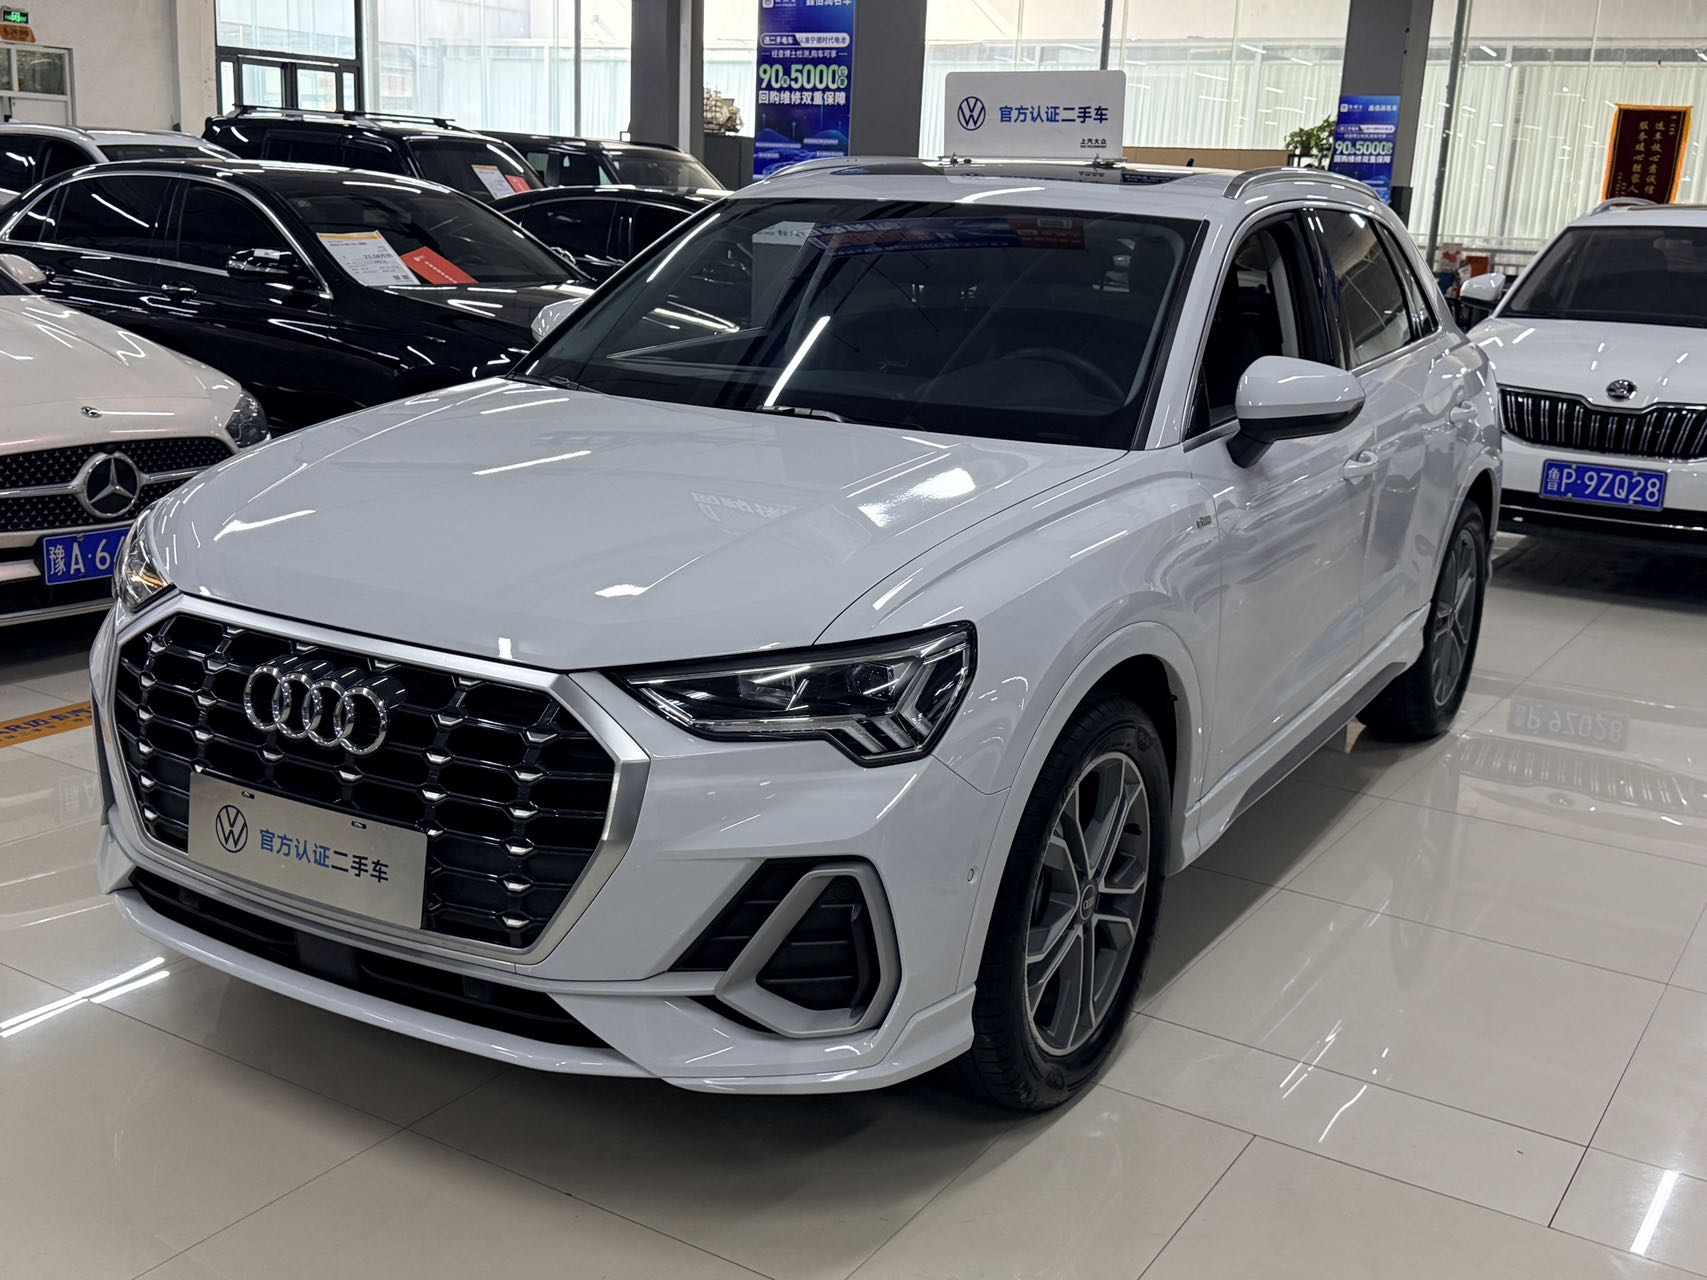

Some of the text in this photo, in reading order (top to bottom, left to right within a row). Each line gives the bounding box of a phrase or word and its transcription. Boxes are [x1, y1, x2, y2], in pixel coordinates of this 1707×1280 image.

[758, 90, 847, 106] 回购维修双重保障
[999, 105, 1109, 124] 官方认证二手车
[1080, 138, 1107, 146] 上汽大众
[259, 828, 390, 884] 官方认证二手车
